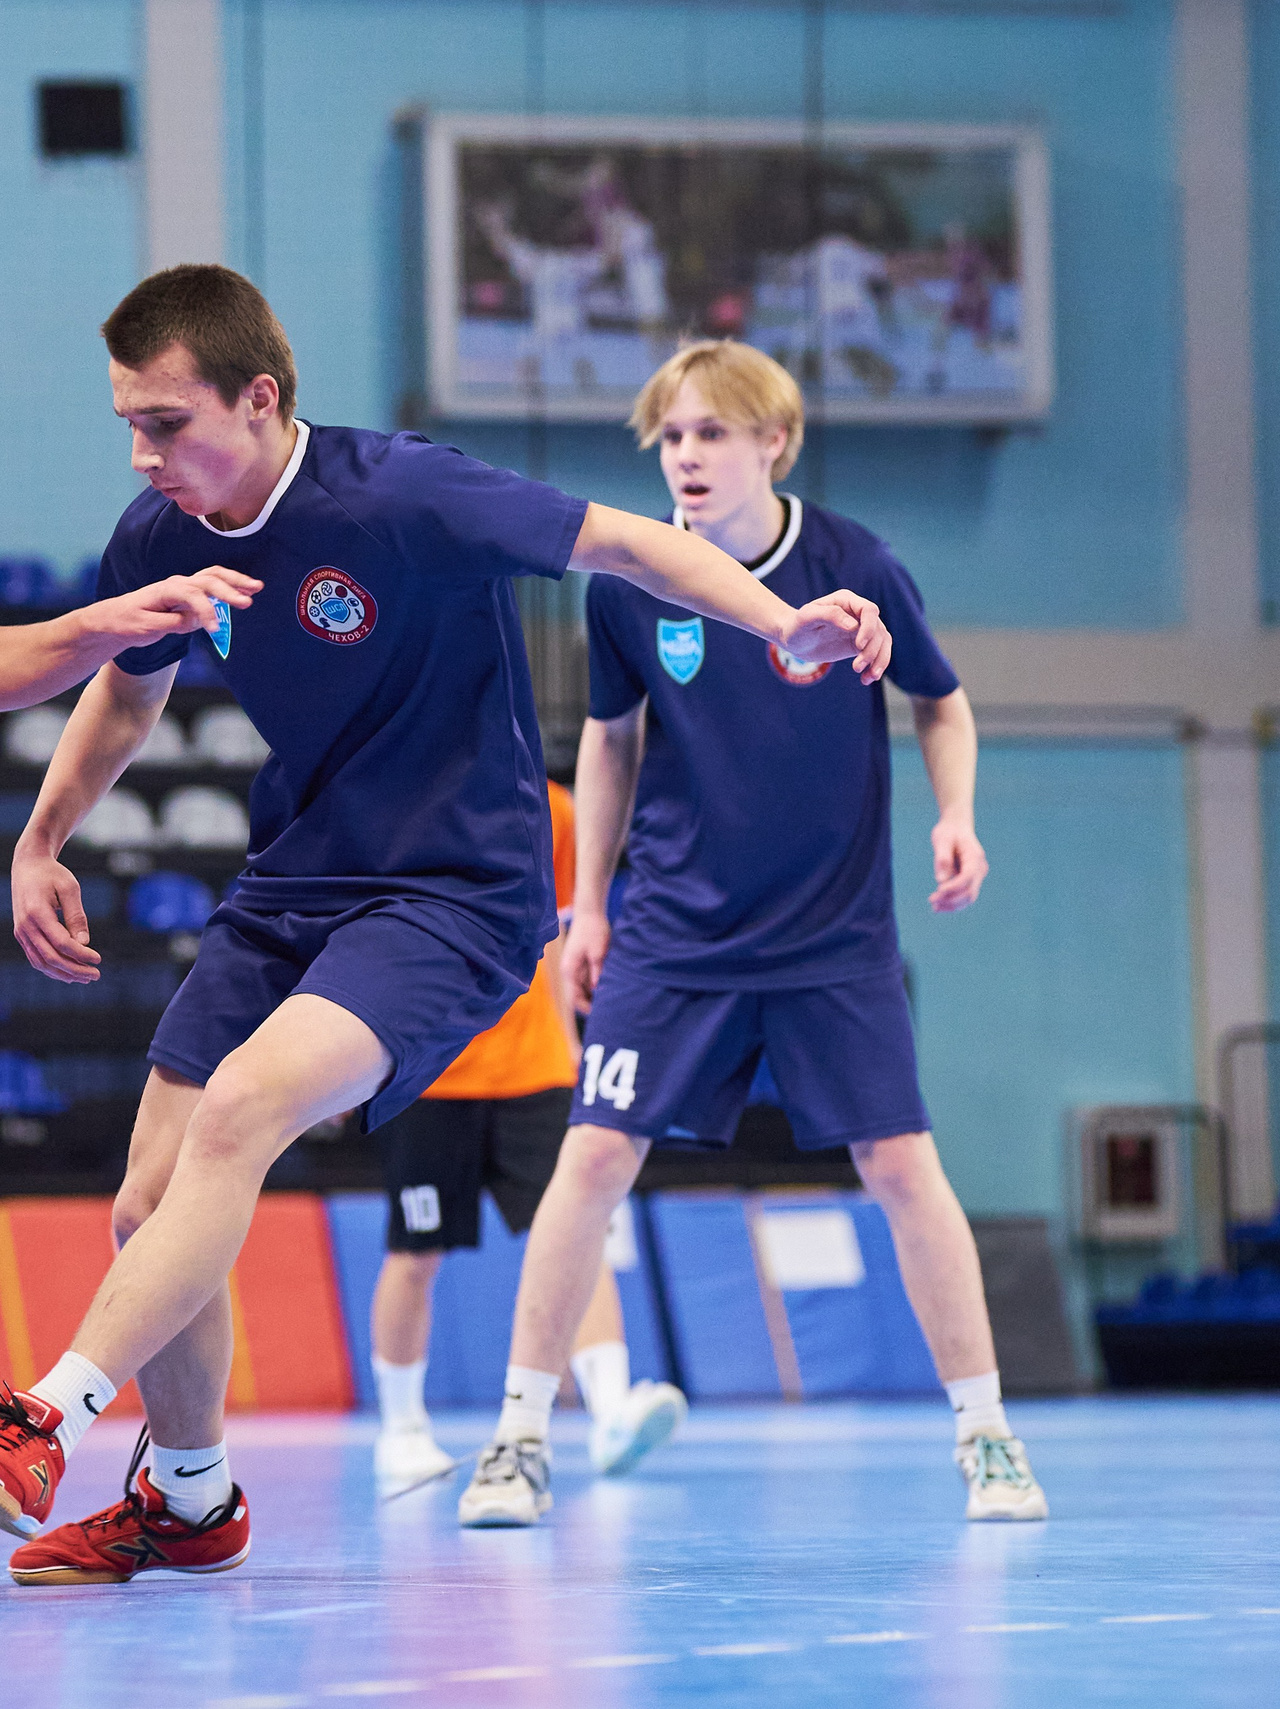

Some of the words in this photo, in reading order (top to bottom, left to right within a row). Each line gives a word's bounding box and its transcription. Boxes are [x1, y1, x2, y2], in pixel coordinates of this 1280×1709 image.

[300, 578, 315, 616] ШКОЛЬНАЯ
[314, 571, 352, 585] СПОРТИВНАЯ
[351, 585, 367, 599] ЛИГА
[328, 624, 370, 642] ЧЕХОВ-2
[582, 1043, 639, 1111] 14
